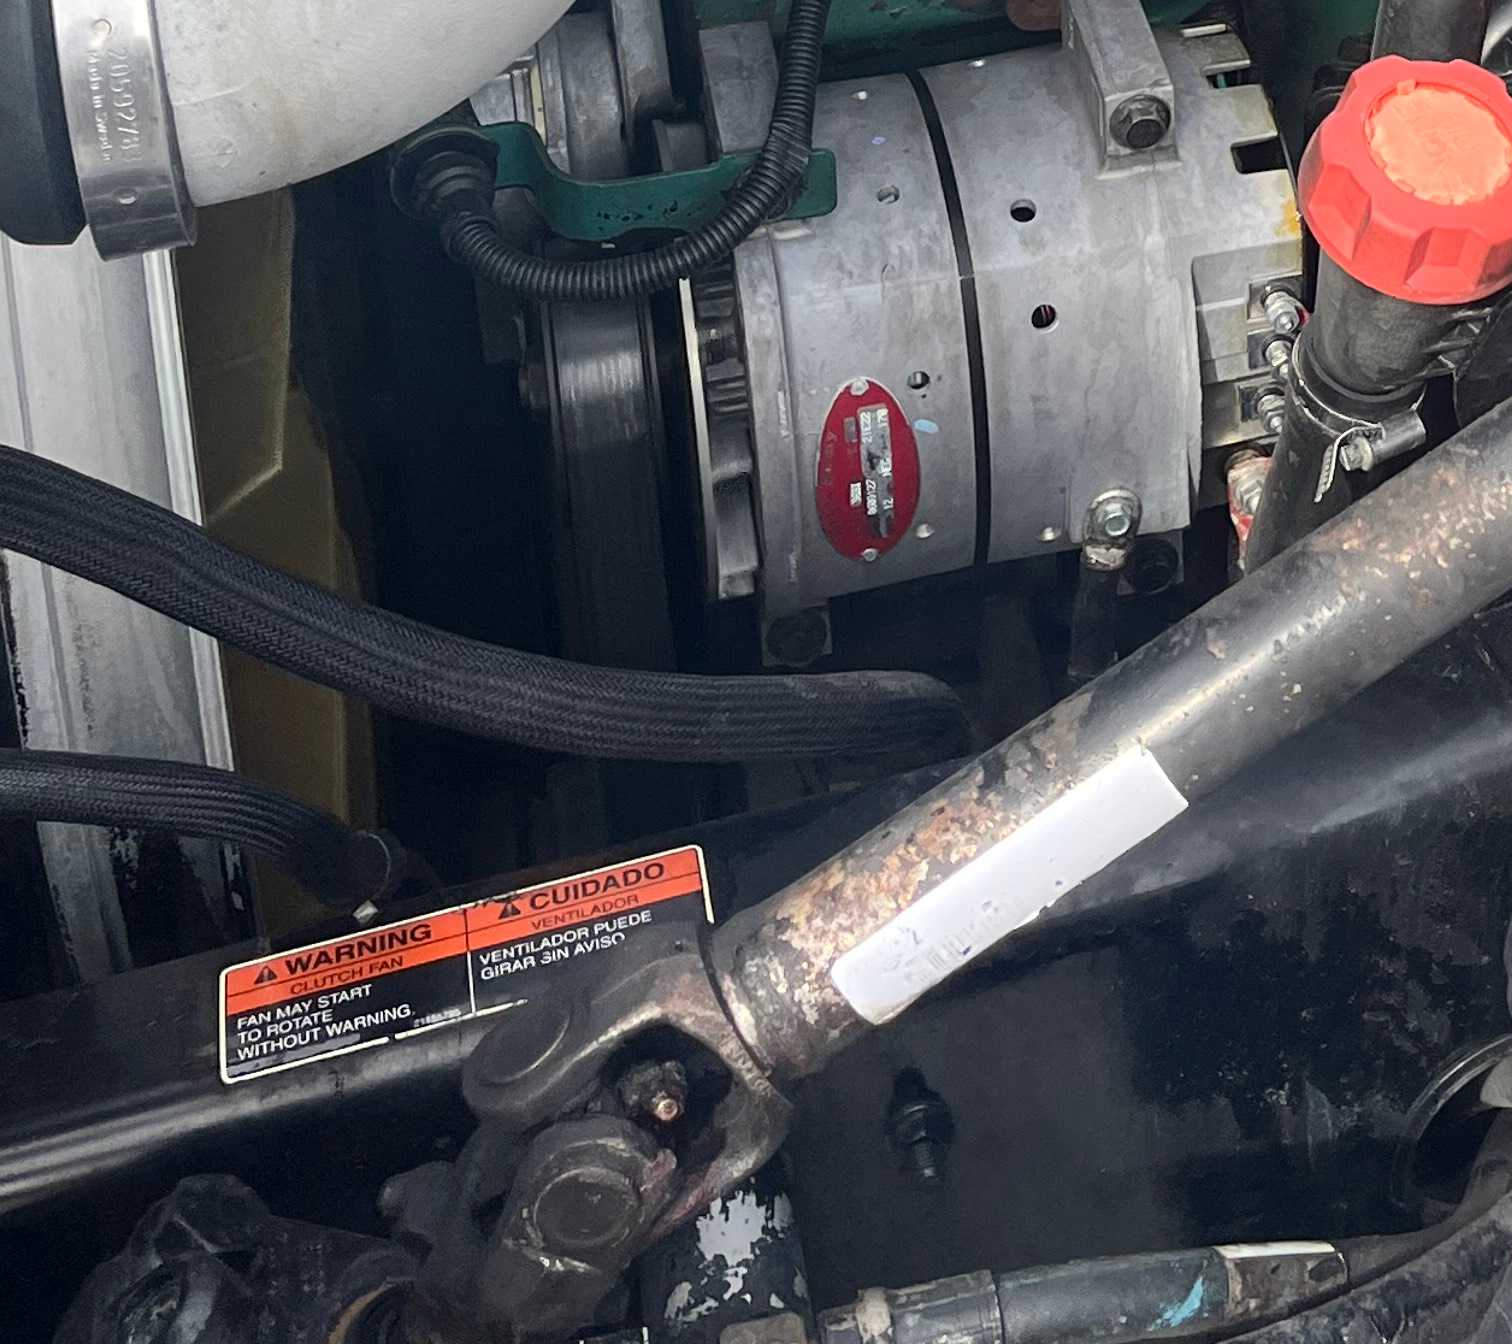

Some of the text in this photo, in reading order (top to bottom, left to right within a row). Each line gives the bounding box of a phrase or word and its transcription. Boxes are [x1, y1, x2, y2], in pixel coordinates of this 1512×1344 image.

[529, 862, 665, 911] CUIDADO
[531, 894, 640, 931] VENTILADOR
[284, 923, 433, 977] WARNING
[479, 910, 653, 966] VENTILADOR PUEDE
[480, 932, 627, 981] GIRAR SIN AVISO
[290, 955, 405, 996] CLUTCH FAN
[236, 983, 373, 1031] FAN MAY START
[237, 1010, 335, 1045] TO ROTATE
[237, 1028, 322, 1061] WITHOUT
